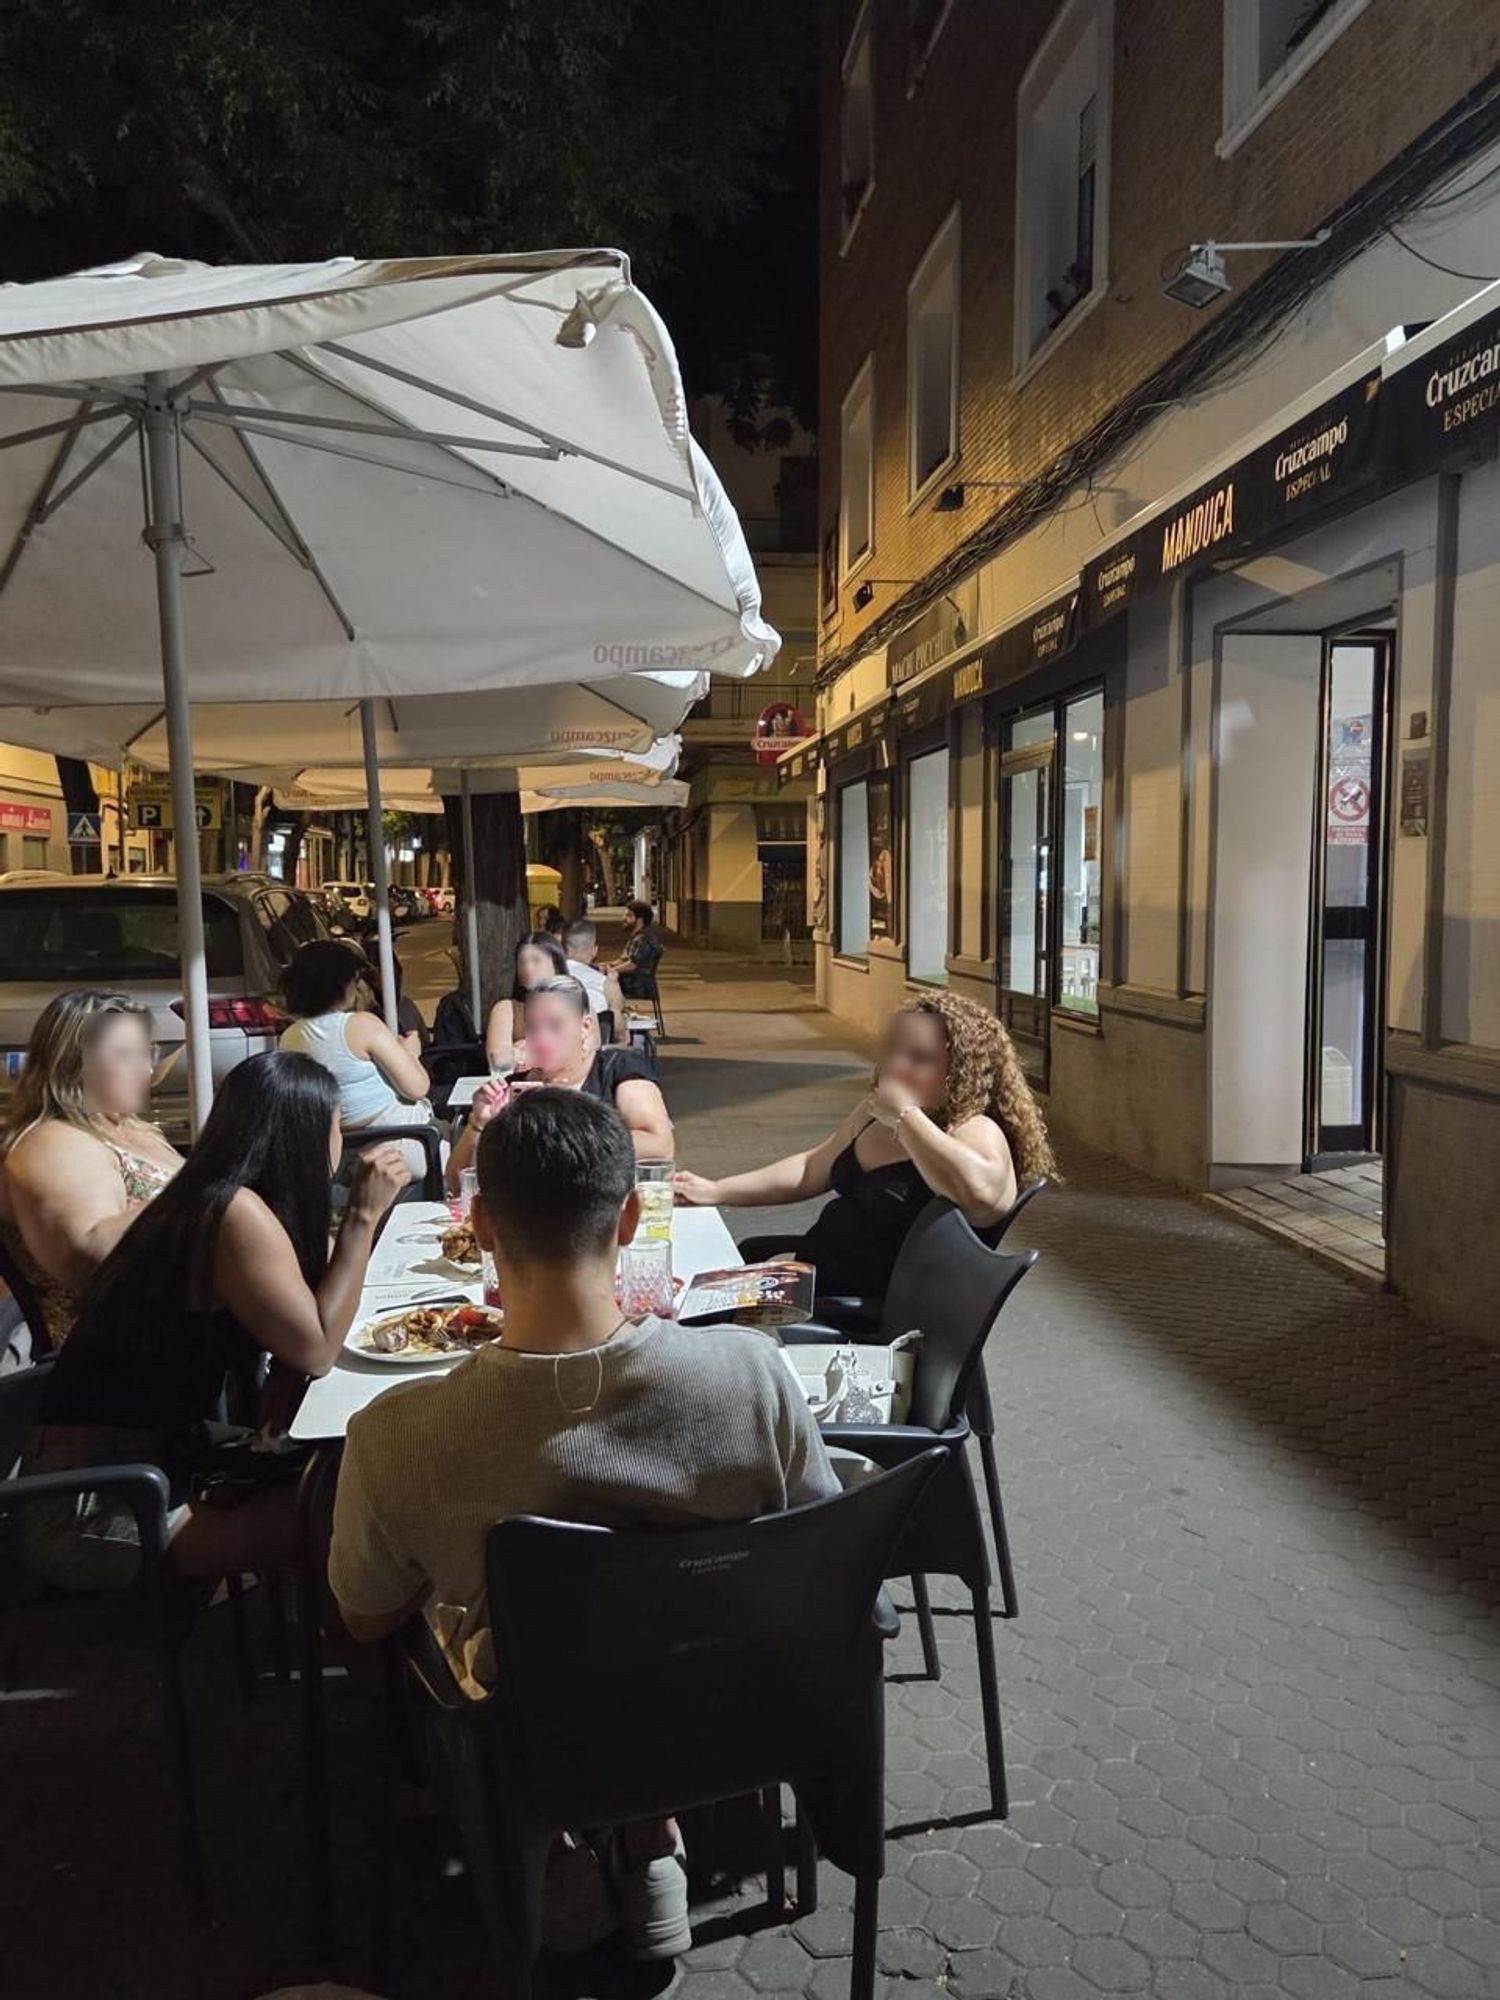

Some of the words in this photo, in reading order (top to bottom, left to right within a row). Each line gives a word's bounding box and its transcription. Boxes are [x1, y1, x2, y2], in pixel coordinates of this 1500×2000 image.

[1275, 419, 1347, 481] Cruzcampo
[1286, 462, 1331, 501] ESPECIAL
[1162, 483, 1233, 574] MANDUCA
[141, 806, 158, 825] P
